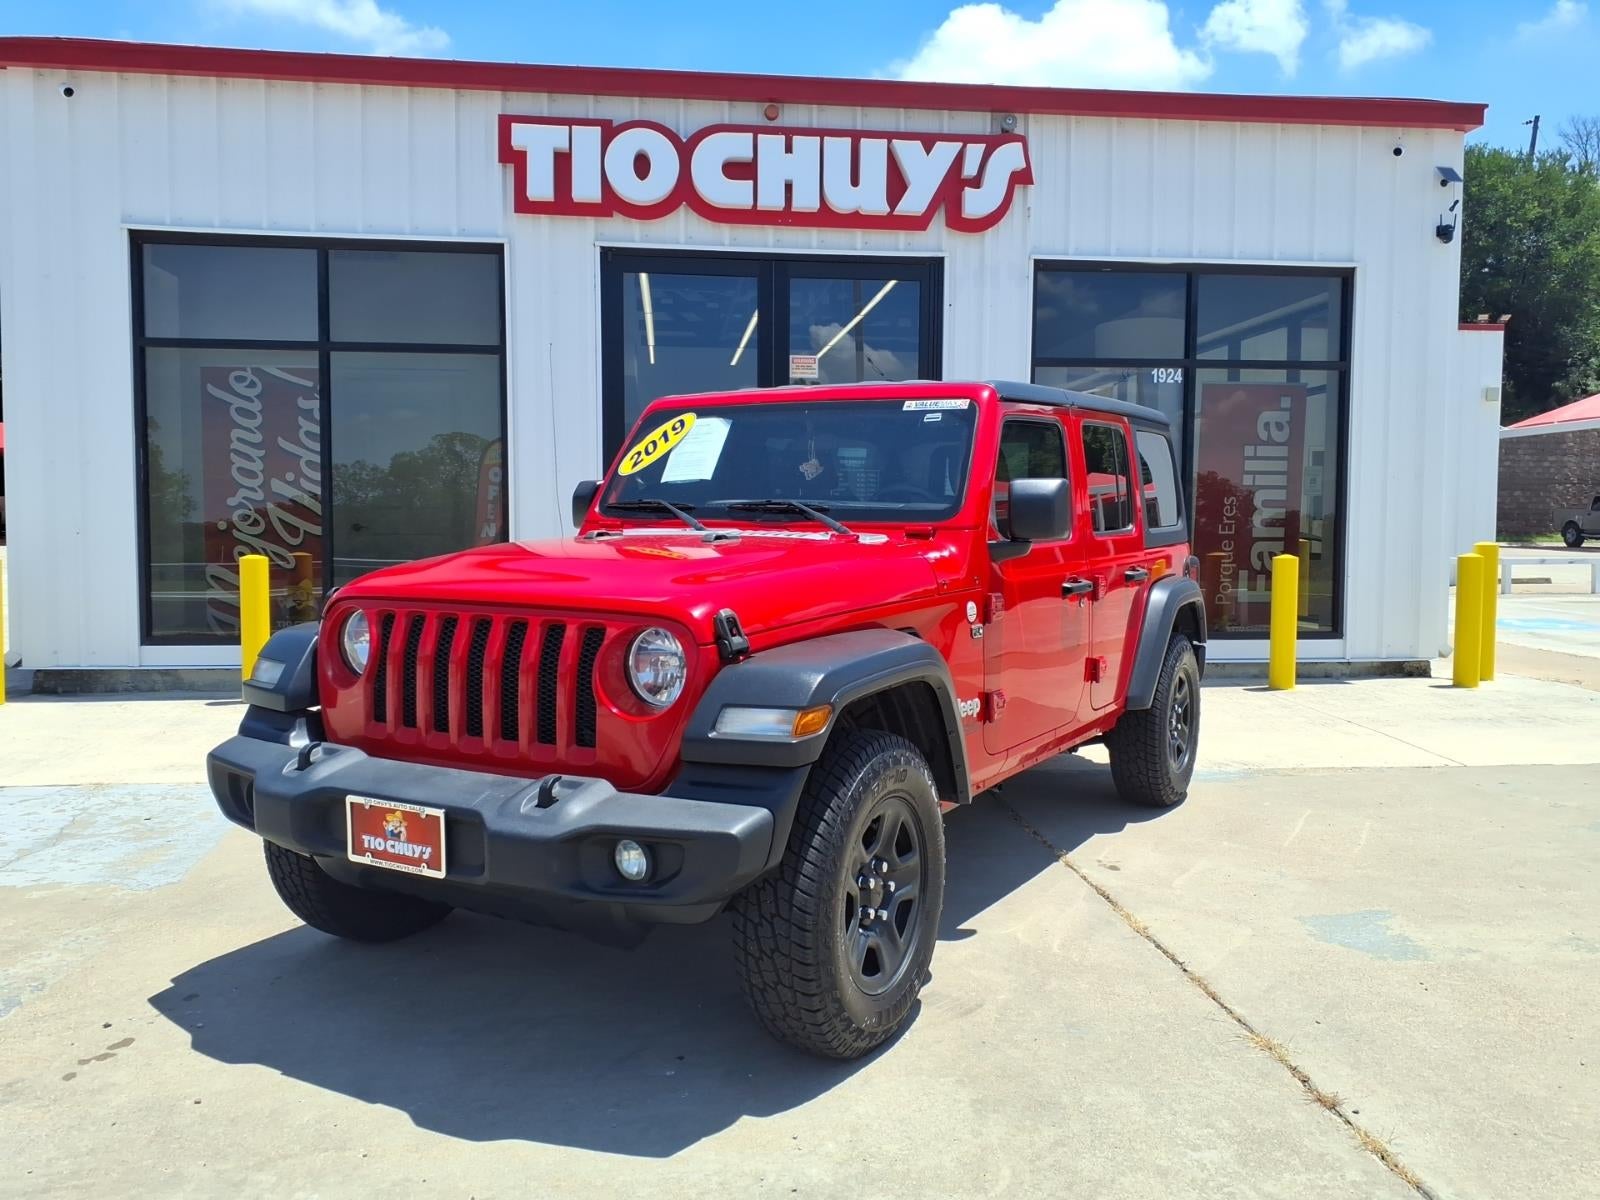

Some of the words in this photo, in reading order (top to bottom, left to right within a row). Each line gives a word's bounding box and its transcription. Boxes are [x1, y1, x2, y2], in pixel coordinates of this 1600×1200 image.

[511, 122, 679, 206] TIO
[690, 131, 1026, 219] CHUY'S
[1151, 368, 1183, 384] 1924
[629, 418, 687, 470] 2019
[1218, 496, 1237, 535] Eres
[1236, 396, 1293, 603] Familia.
[1216, 540, 1237, 604] Porque
[362, 835, 385, 851] TIO
[386, 839, 432, 860] CHUY'S
